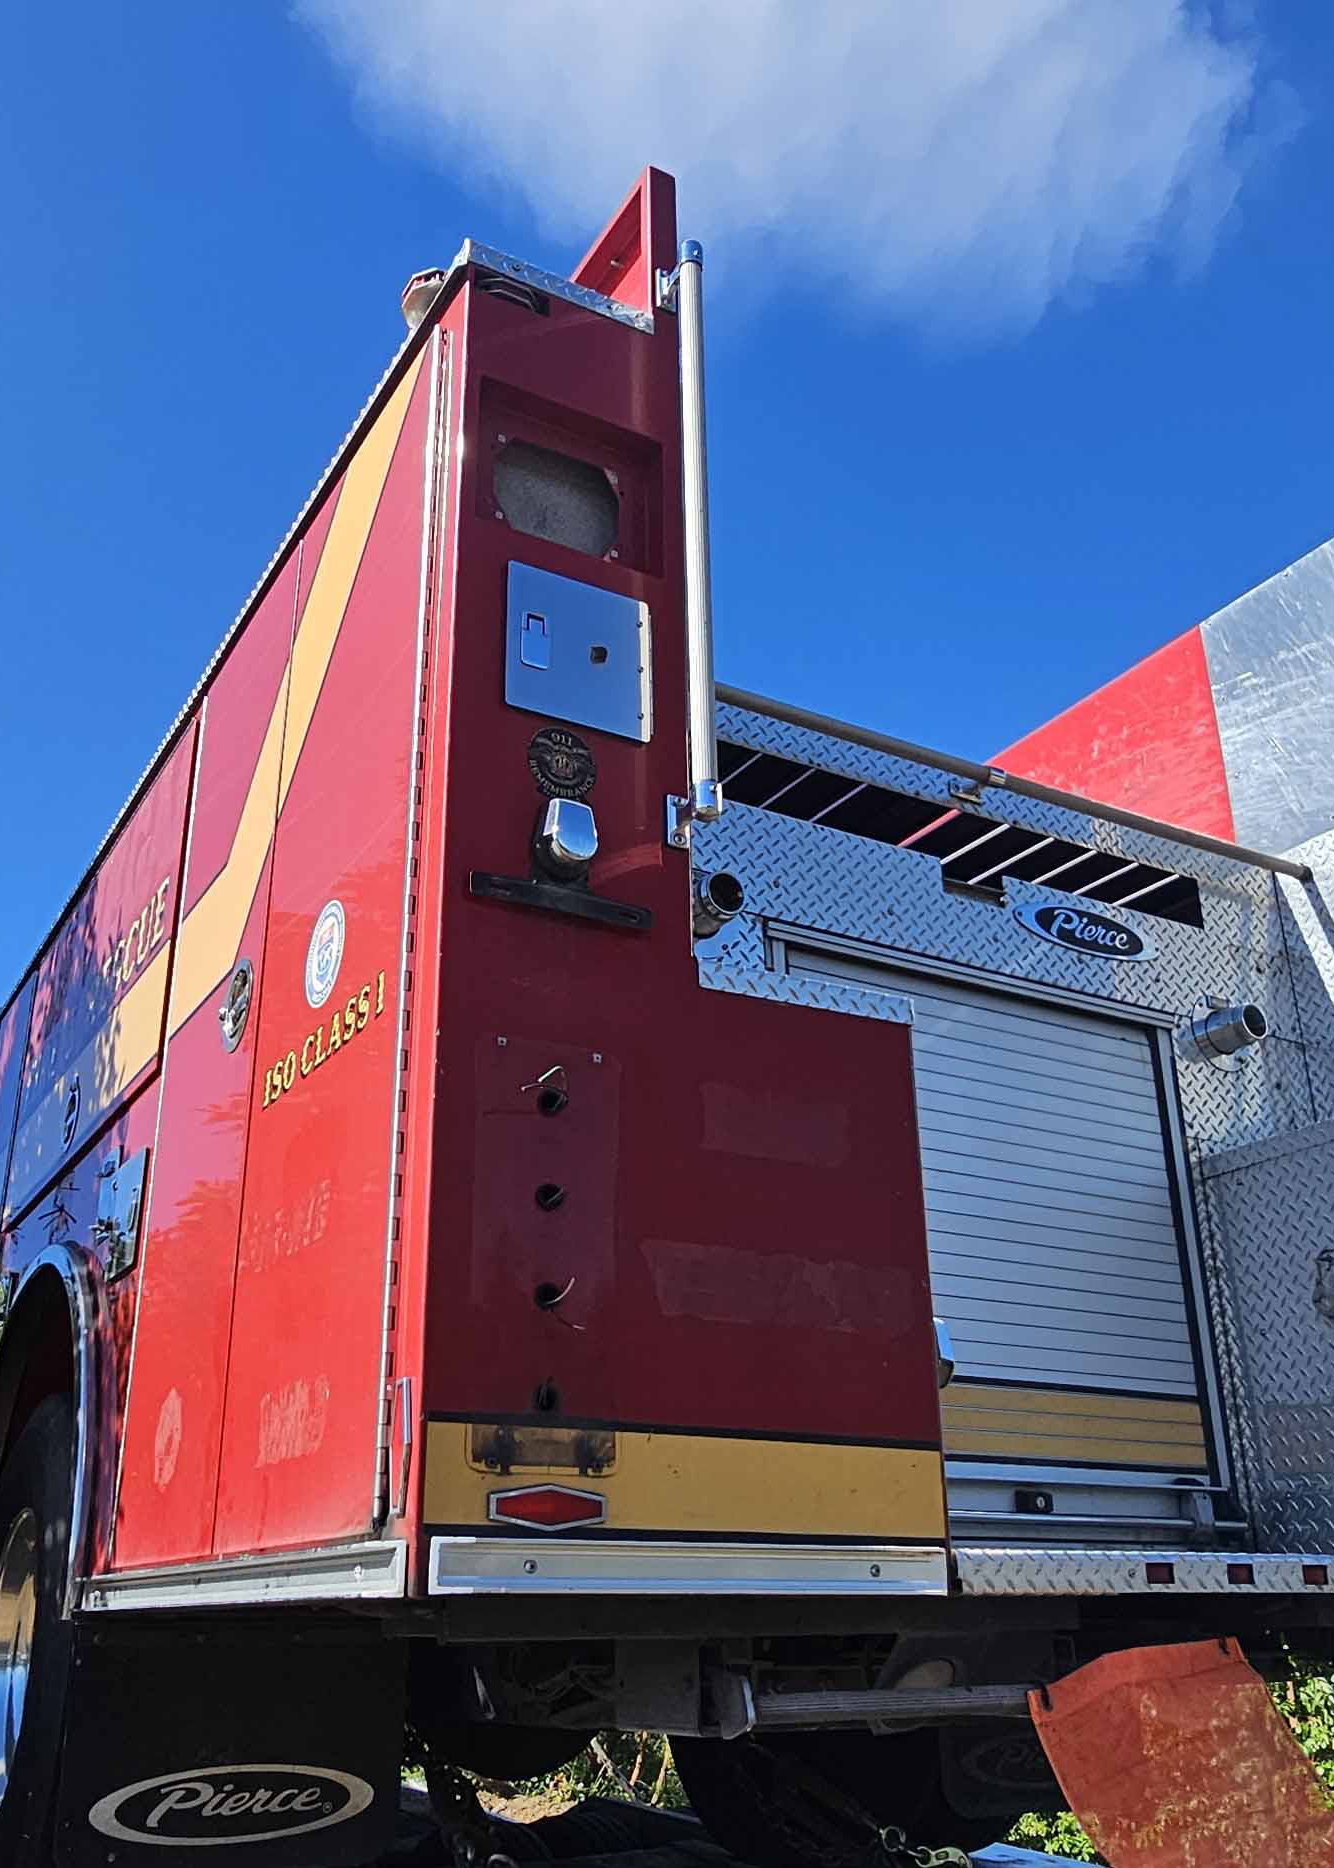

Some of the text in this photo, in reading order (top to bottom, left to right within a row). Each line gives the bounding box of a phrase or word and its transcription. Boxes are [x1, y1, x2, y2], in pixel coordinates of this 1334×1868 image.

[551, 732, 572, 746] 911
[1050, 909, 1130, 949] Pierce
[263, 1050, 296, 1109] ISO
[300, 984, 371, 1077] CLASS
[146, 1782, 323, 1828] Pierce
